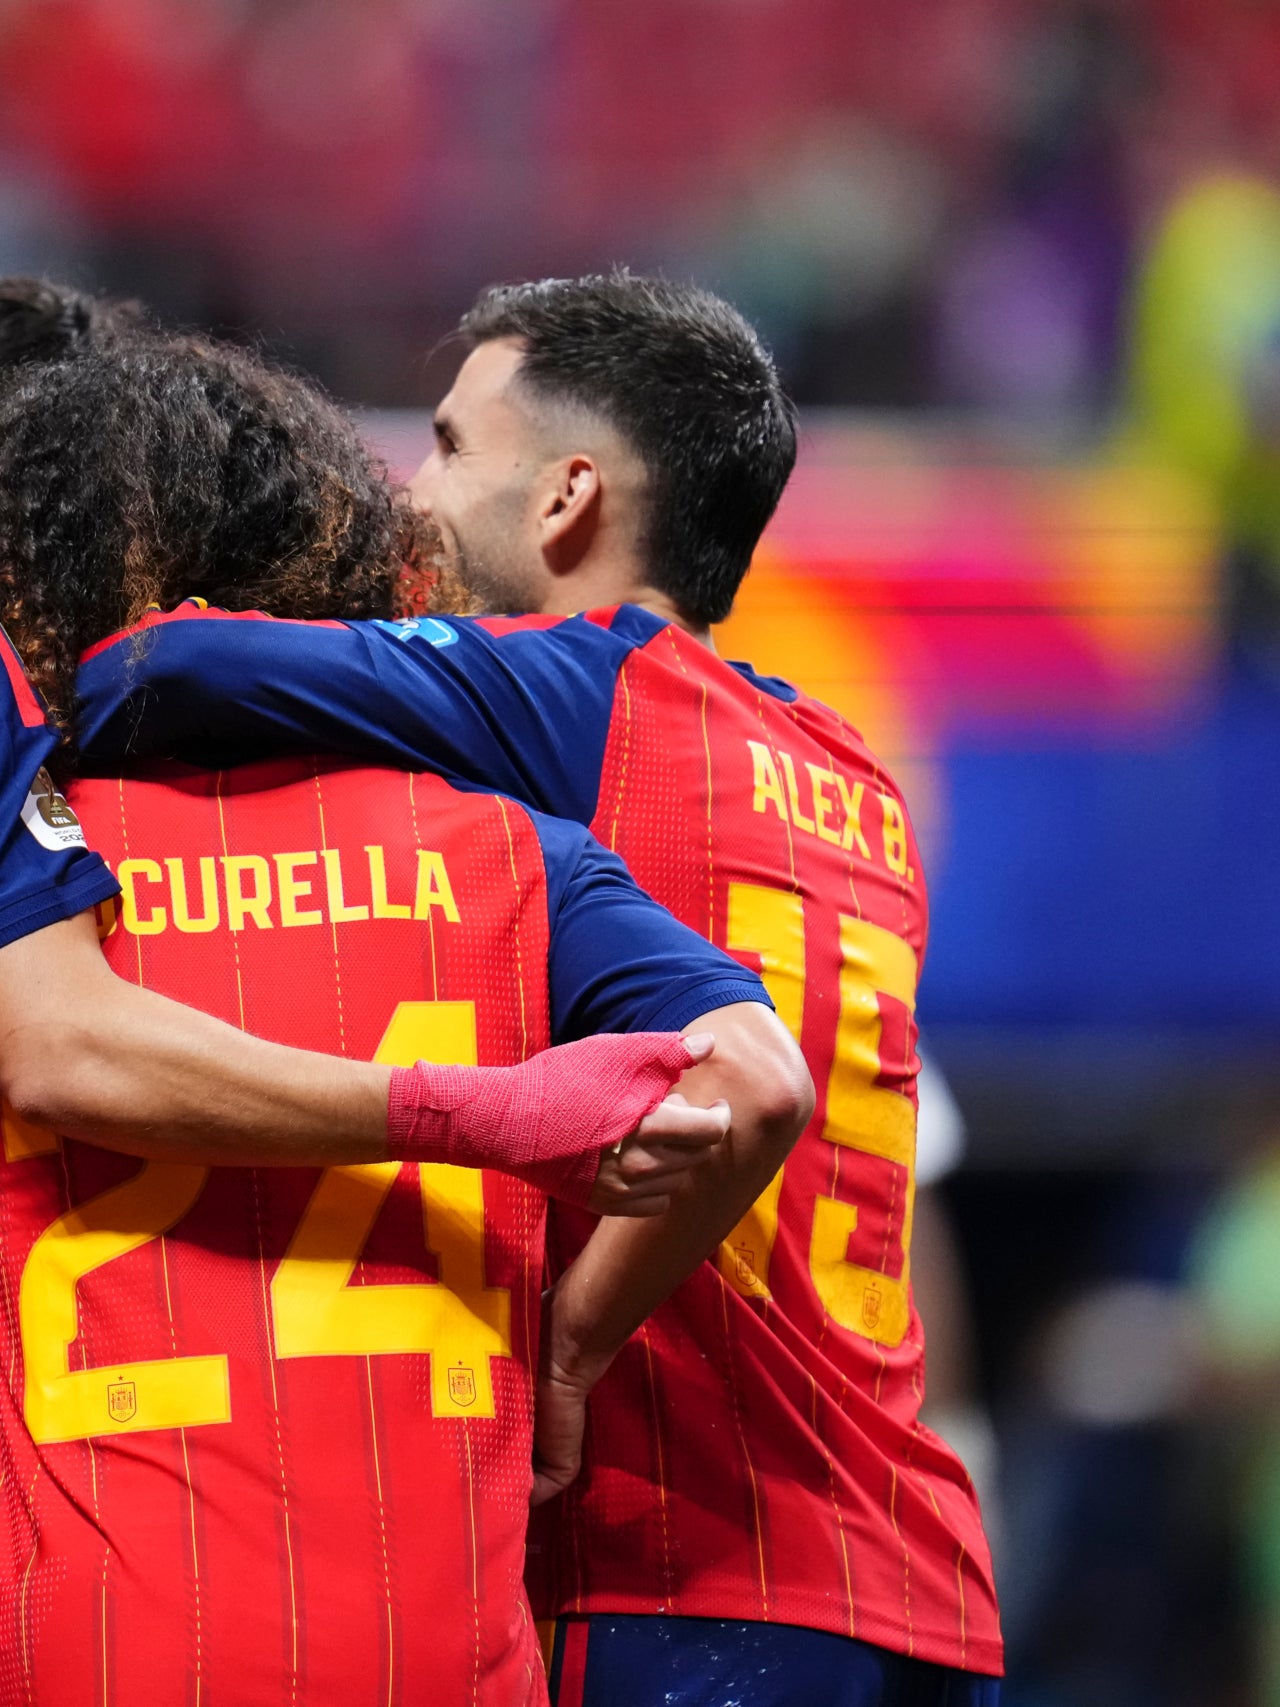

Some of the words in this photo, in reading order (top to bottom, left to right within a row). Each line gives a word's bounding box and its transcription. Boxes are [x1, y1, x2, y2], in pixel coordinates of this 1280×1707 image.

[746, 739, 872, 860] ALEX
[877, 793, 915, 884] B.
[1, 1000, 512, 1445] 24
[721, 881, 918, 1348] 15
